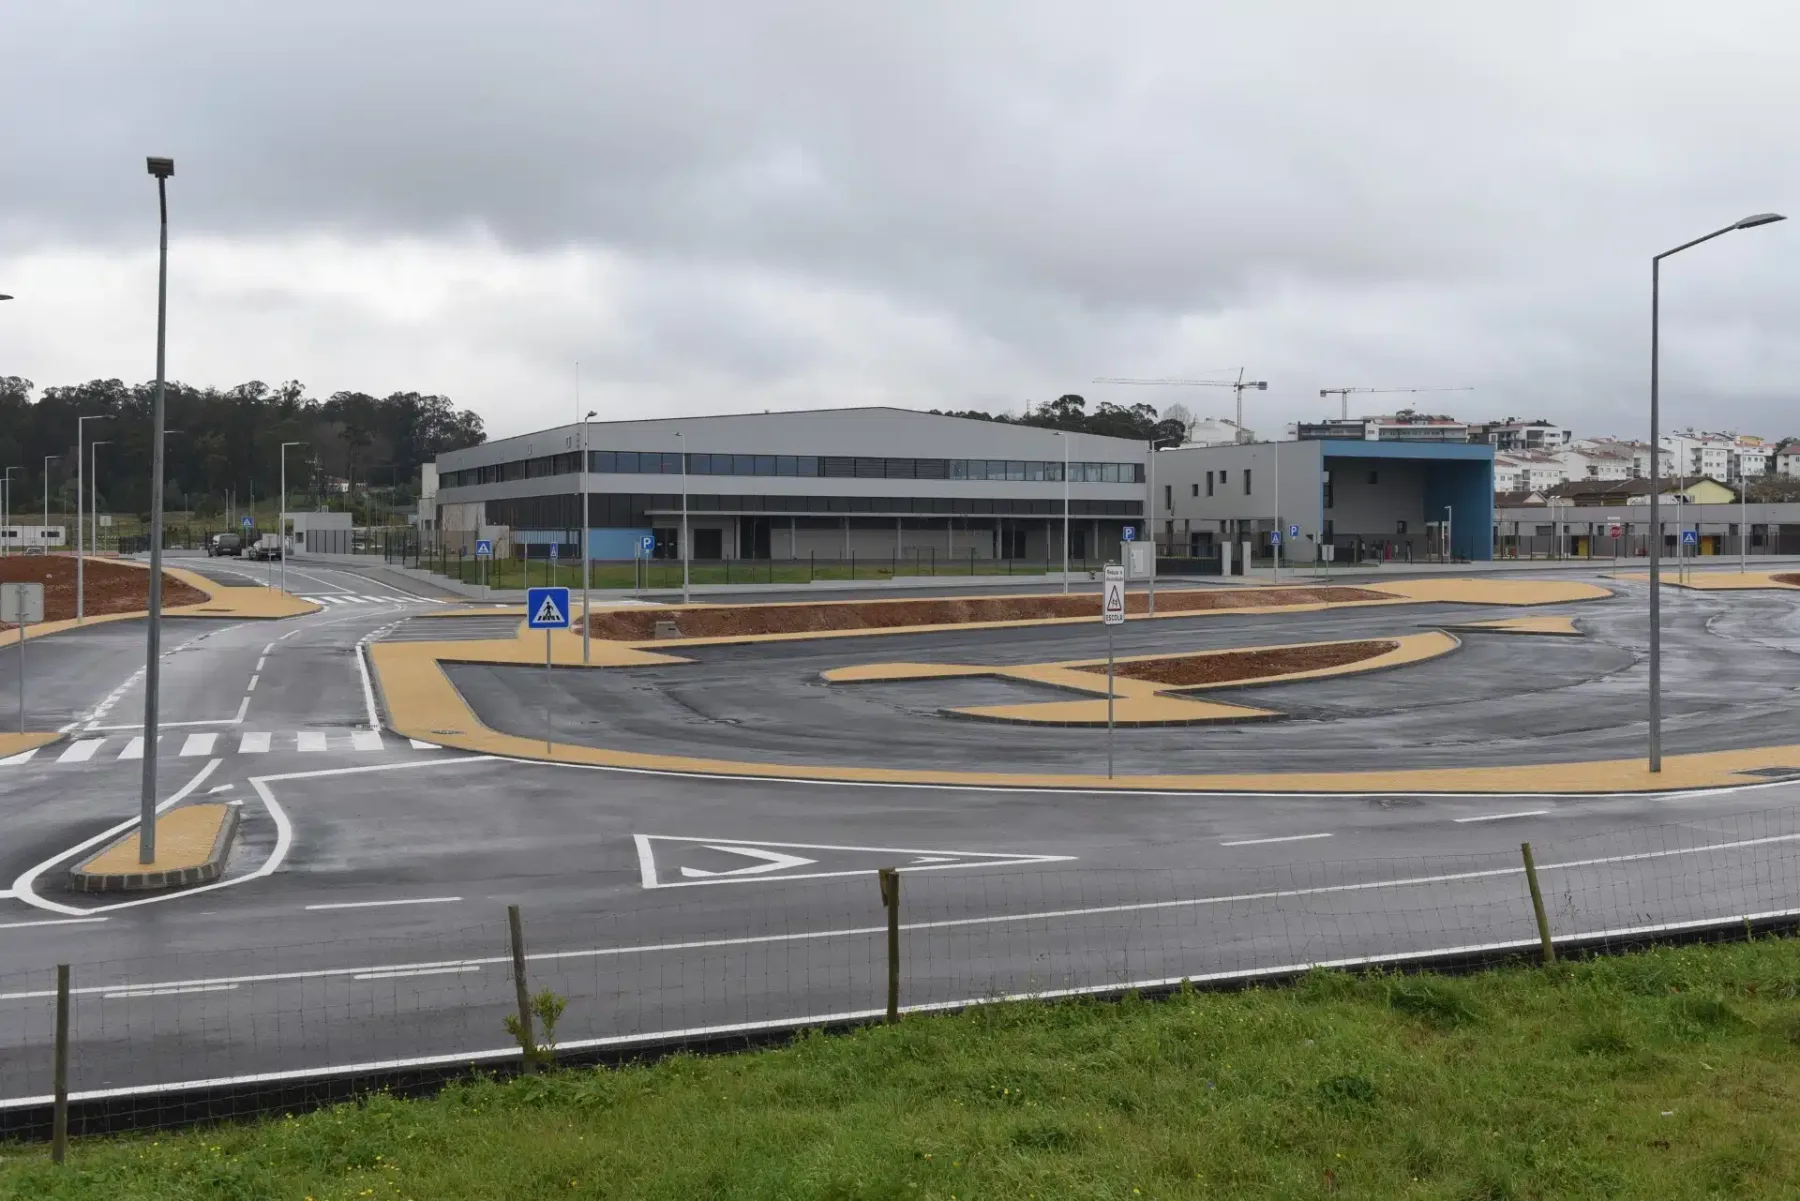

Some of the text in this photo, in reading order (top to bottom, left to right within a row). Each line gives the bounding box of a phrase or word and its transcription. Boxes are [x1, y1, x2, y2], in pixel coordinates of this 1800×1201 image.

[1126, 528, 1133, 538] P
[1291, 526, 1297, 536] P
[643, 537, 651, 548] P
[1106, 614, 1123, 622] ESCOLA
